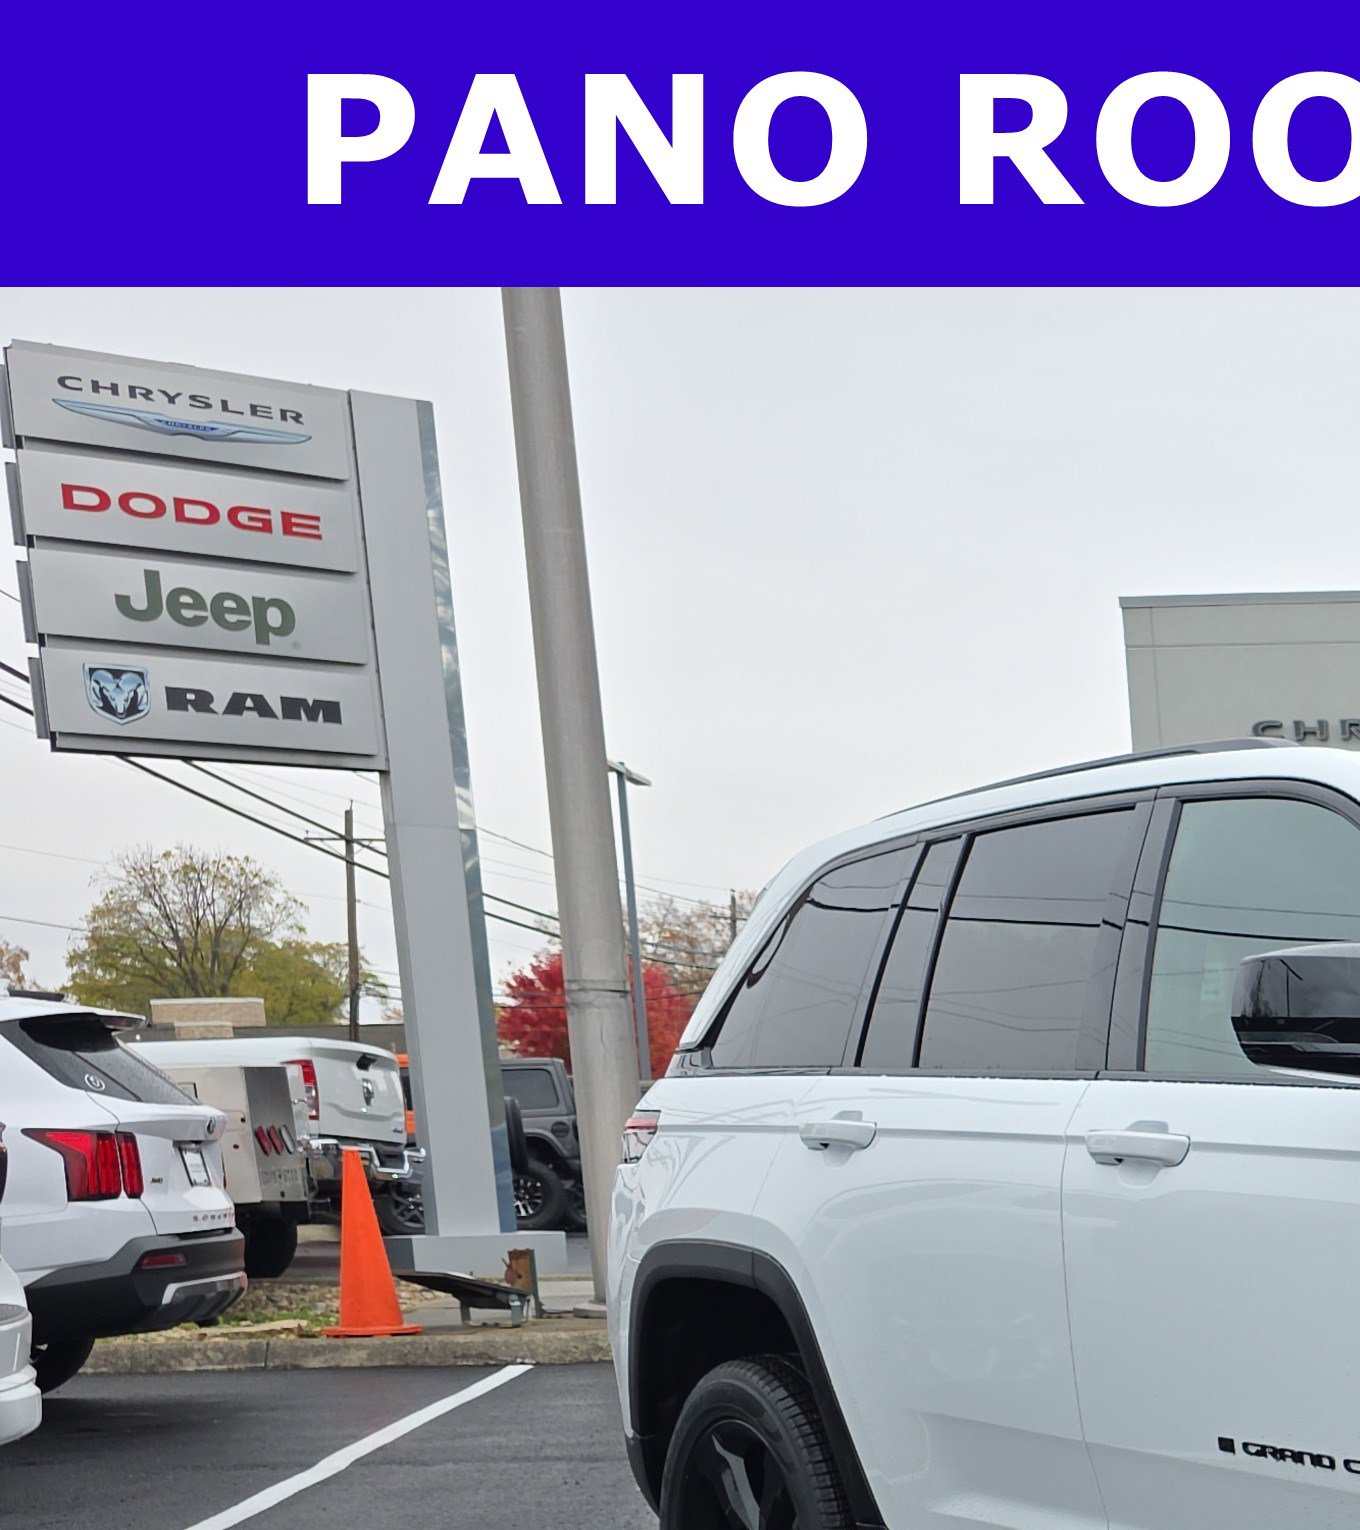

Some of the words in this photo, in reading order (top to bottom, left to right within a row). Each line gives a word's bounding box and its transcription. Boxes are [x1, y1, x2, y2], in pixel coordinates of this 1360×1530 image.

[57, 375, 304, 425] CHRYSLER
[61, 483, 322, 540] DODGE
[114, 568, 296, 646] Jeep
[164, 686, 342, 725] RAM
[1241, 1441, 1336, 1471] GRAND
